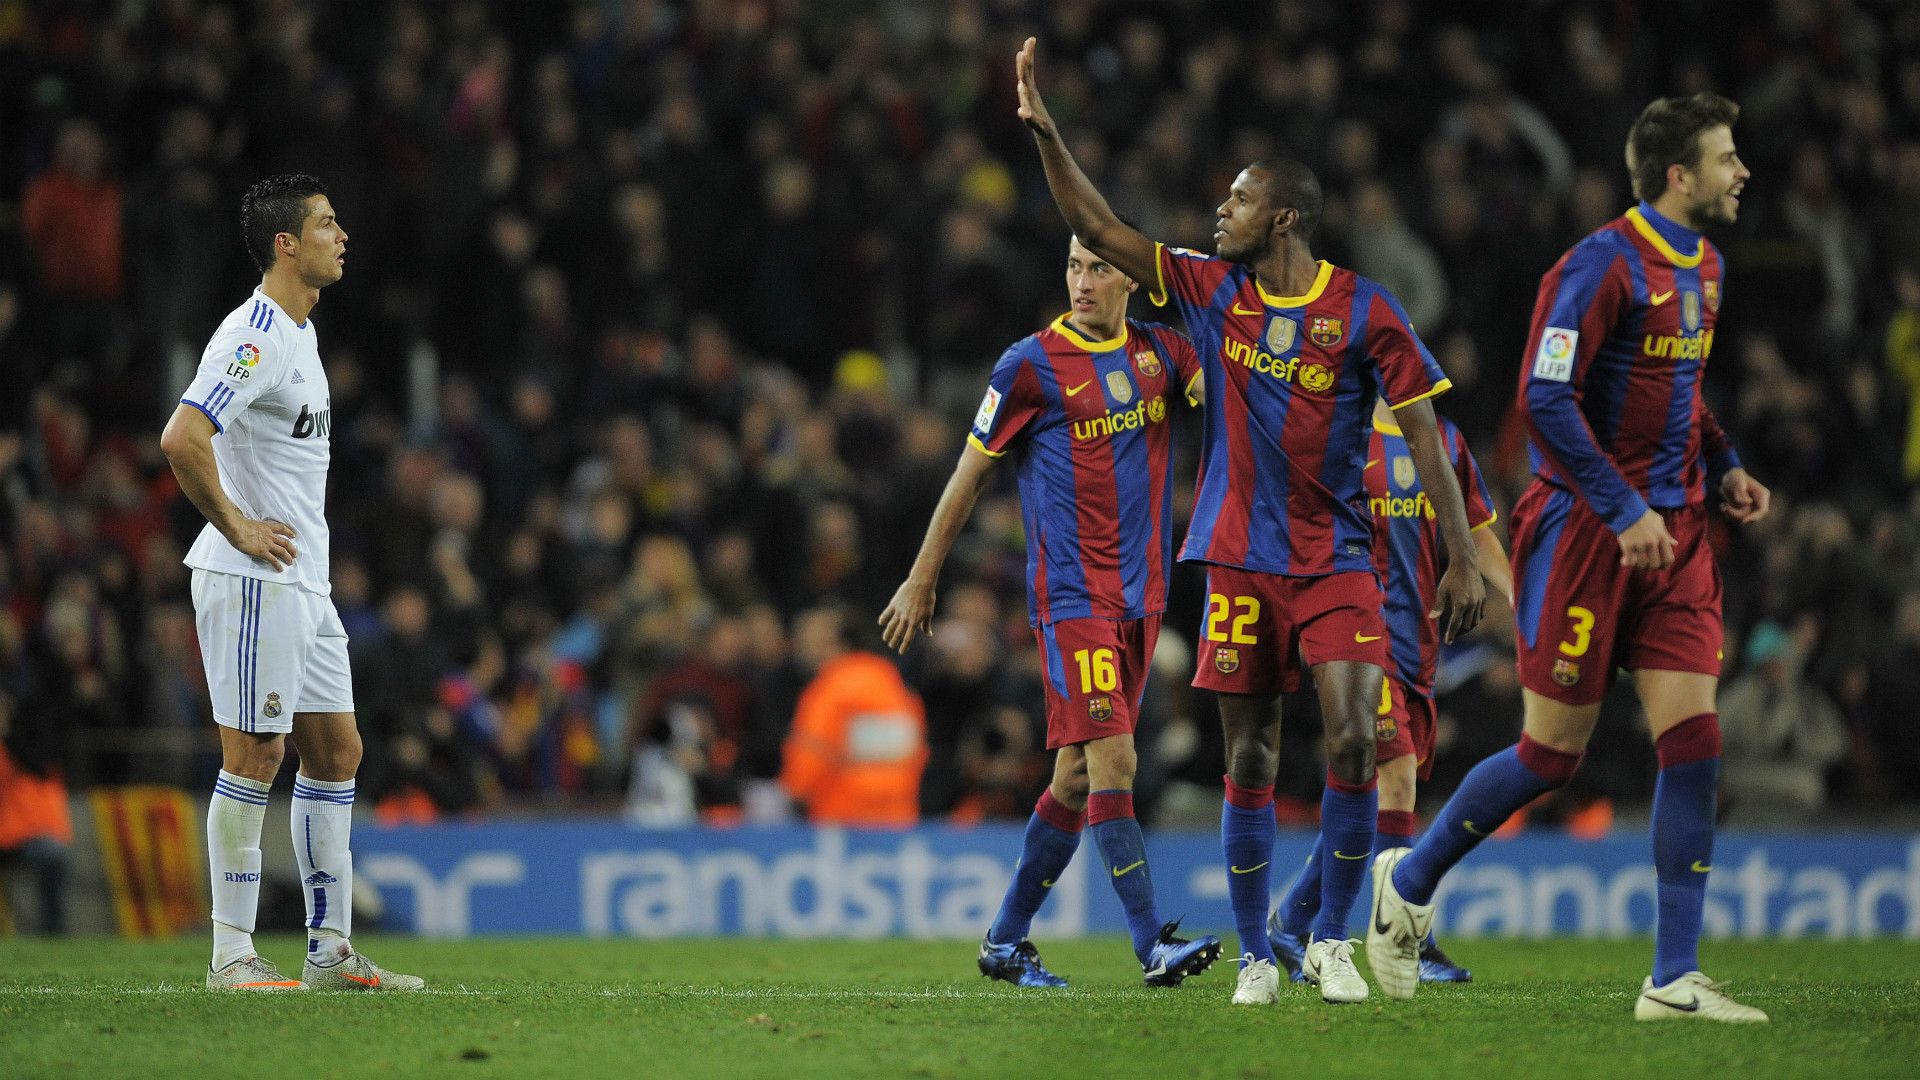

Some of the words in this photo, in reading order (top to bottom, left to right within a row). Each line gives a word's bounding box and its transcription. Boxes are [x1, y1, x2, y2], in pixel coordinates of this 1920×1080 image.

[1225, 336, 1300, 382] unicef
[1643, 329, 1705, 360] unicef
[226, 363, 250, 380] LFP
[1074, 400, 1146, 440] unicef
[1367, 491, 1426, 518] nicef
[1207, 593, 1260, 645] 22
[1558, 606, 1595, 657] 3
[1074, 648, 1117, 693] 16
